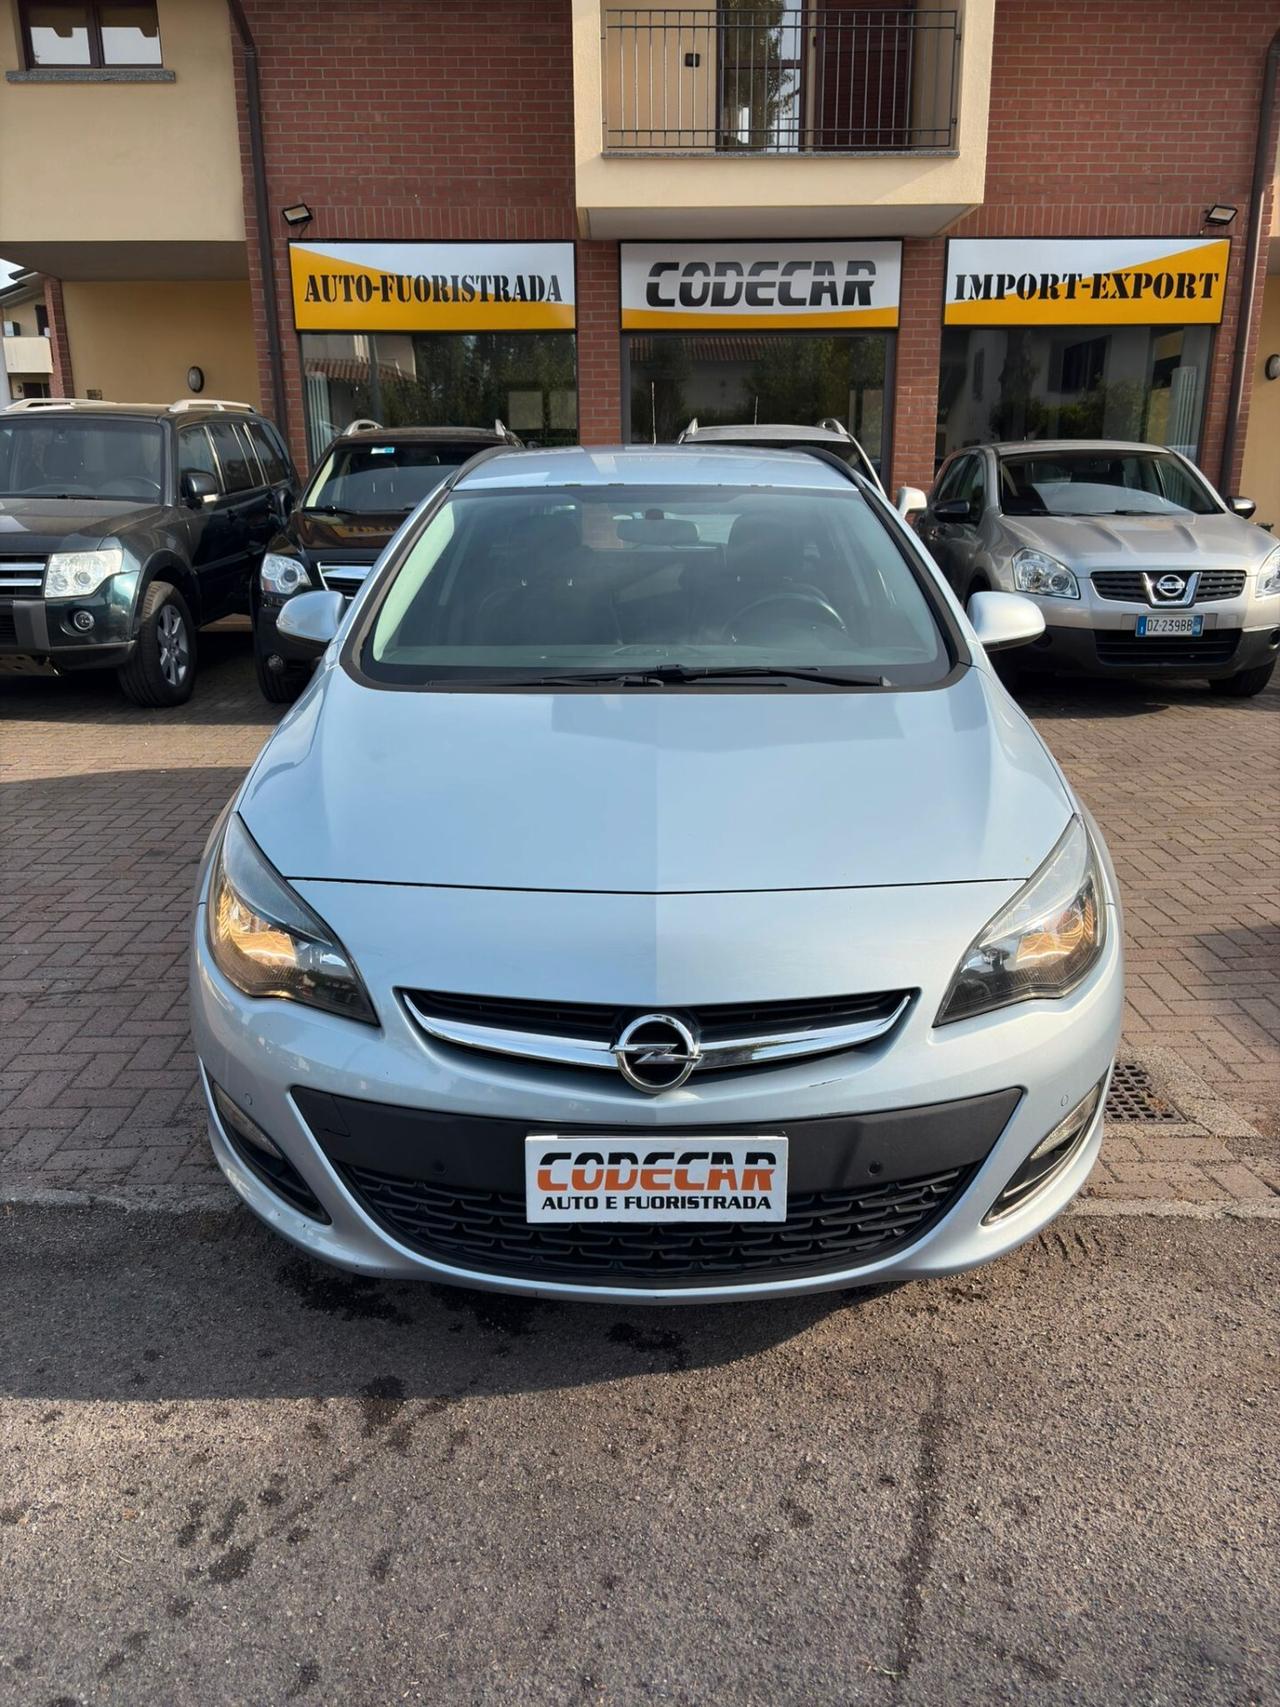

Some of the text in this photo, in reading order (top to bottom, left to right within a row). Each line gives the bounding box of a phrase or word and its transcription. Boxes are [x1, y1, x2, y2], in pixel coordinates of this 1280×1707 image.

[304, 274, 563, 303] AUTO-FUORISTRADA
[646, 260, 877, 307] CODECAR
[954, 272, 1219, 301] IMPORT-EXPORT
[537, 1152, 777, 1191] CODECAR
[541, 1196, 772, 1210] AUTO E FUORISTRADA
